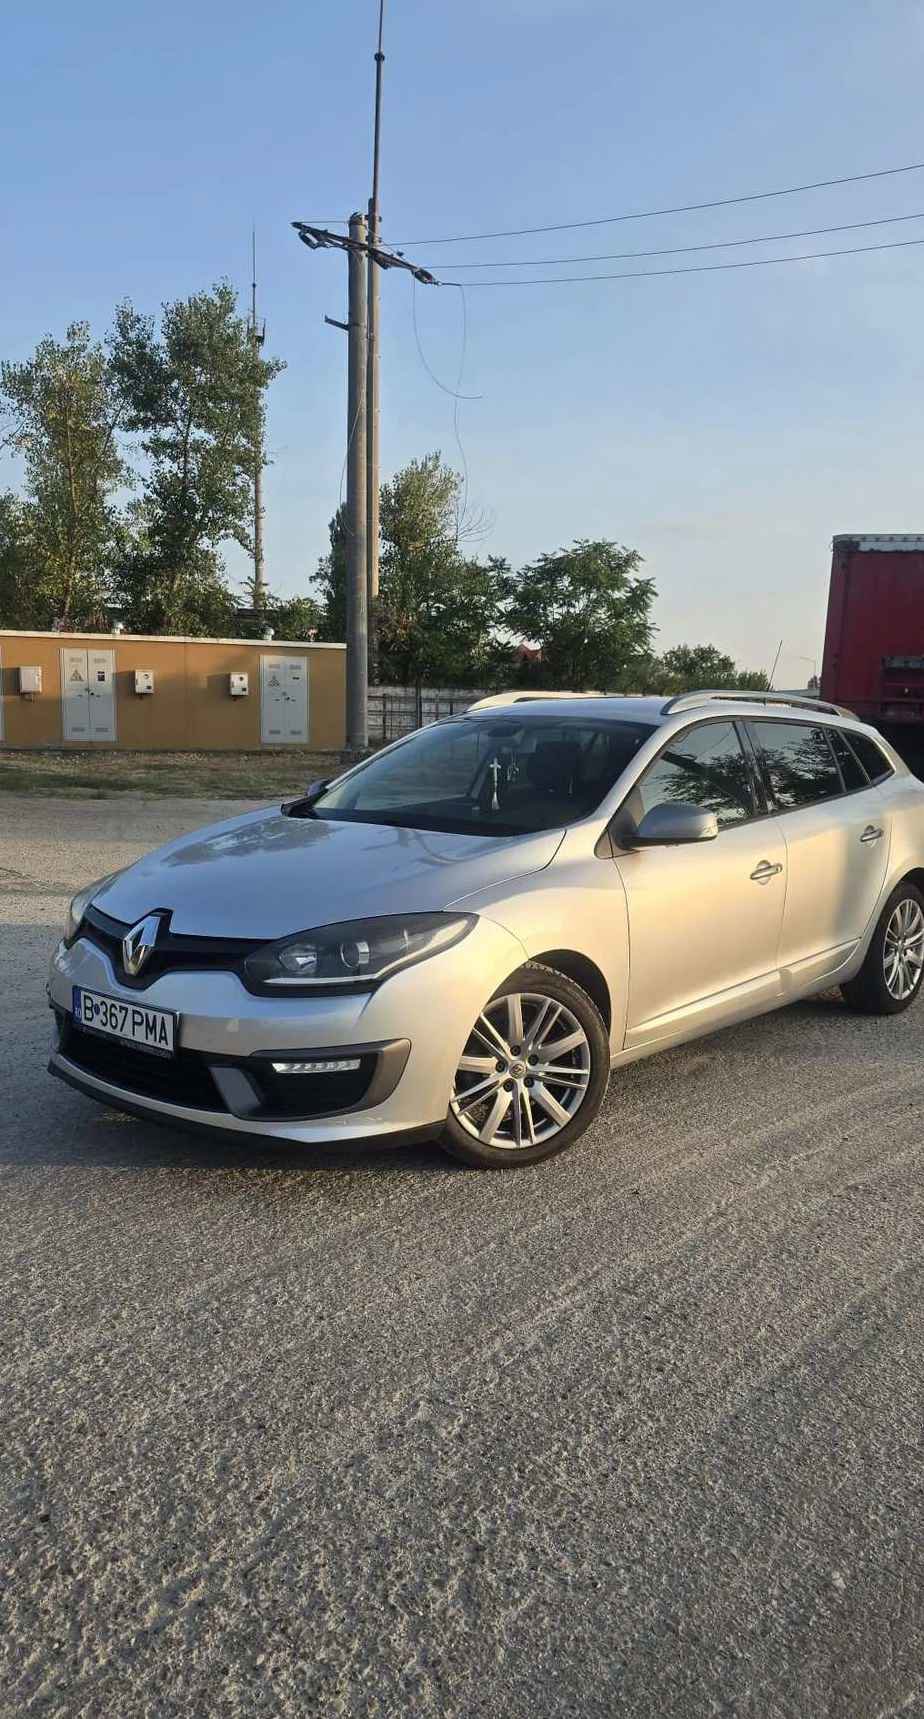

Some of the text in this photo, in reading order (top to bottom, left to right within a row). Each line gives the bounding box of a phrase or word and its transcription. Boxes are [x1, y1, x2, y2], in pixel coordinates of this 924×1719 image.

[83, 994, 169, 1046] B 367 PMA
